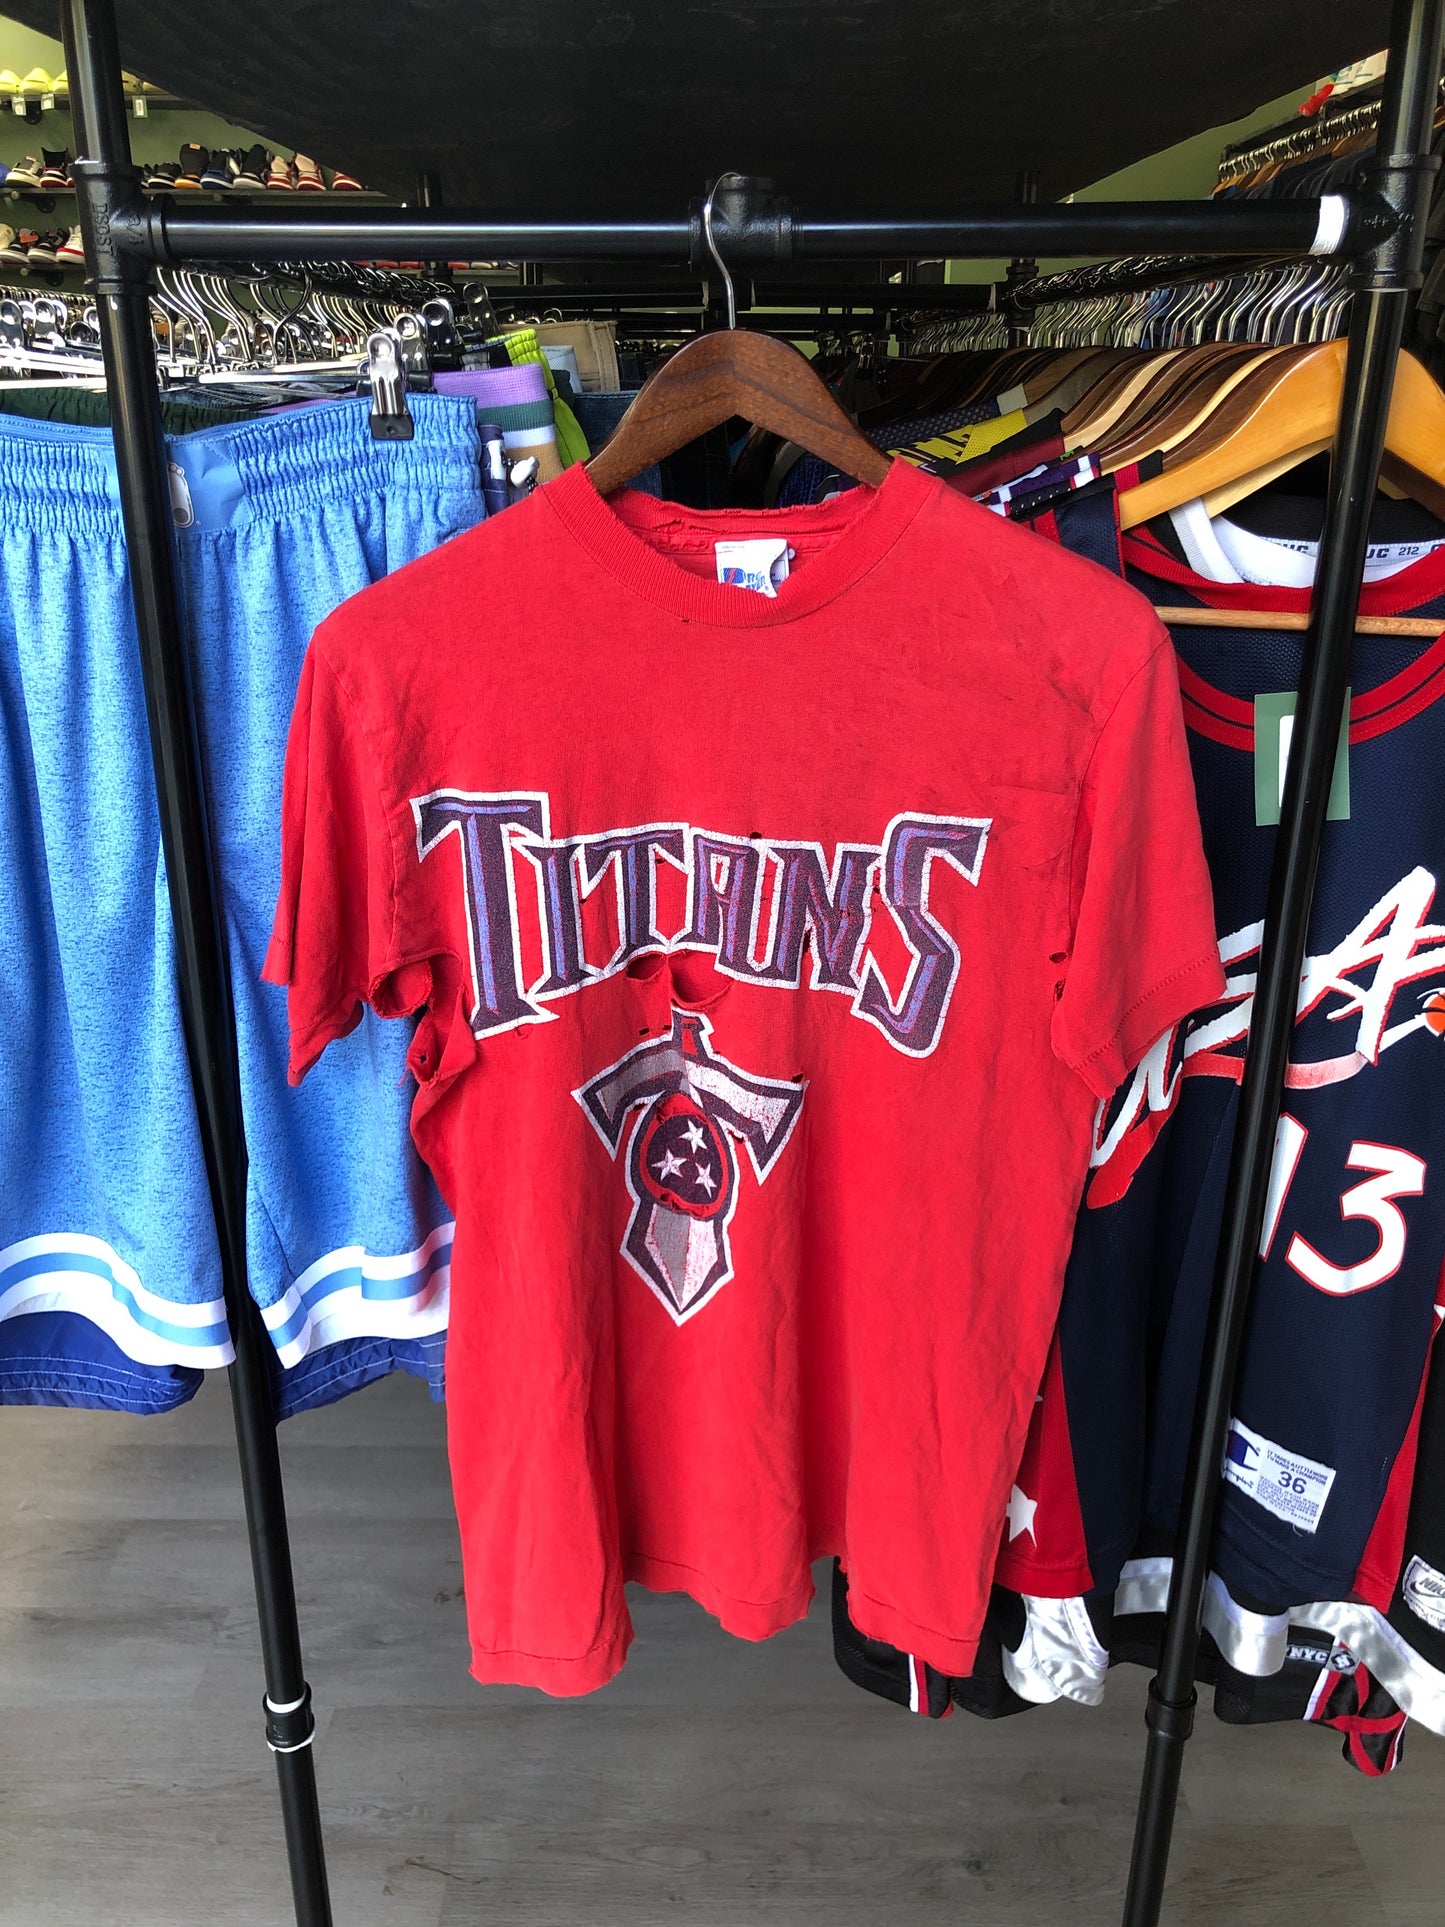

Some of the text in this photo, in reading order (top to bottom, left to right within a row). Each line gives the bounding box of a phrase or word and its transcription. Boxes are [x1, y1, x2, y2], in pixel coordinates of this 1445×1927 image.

[1398, 546, 1420, 556] 212
[409, 788, 993, 1059] TITANS
[1258, 1112, 1427, 1297] 13
[1278, 1470, 1307, 1495] 36
[1289, 1646, 1328, 1662] NYC
